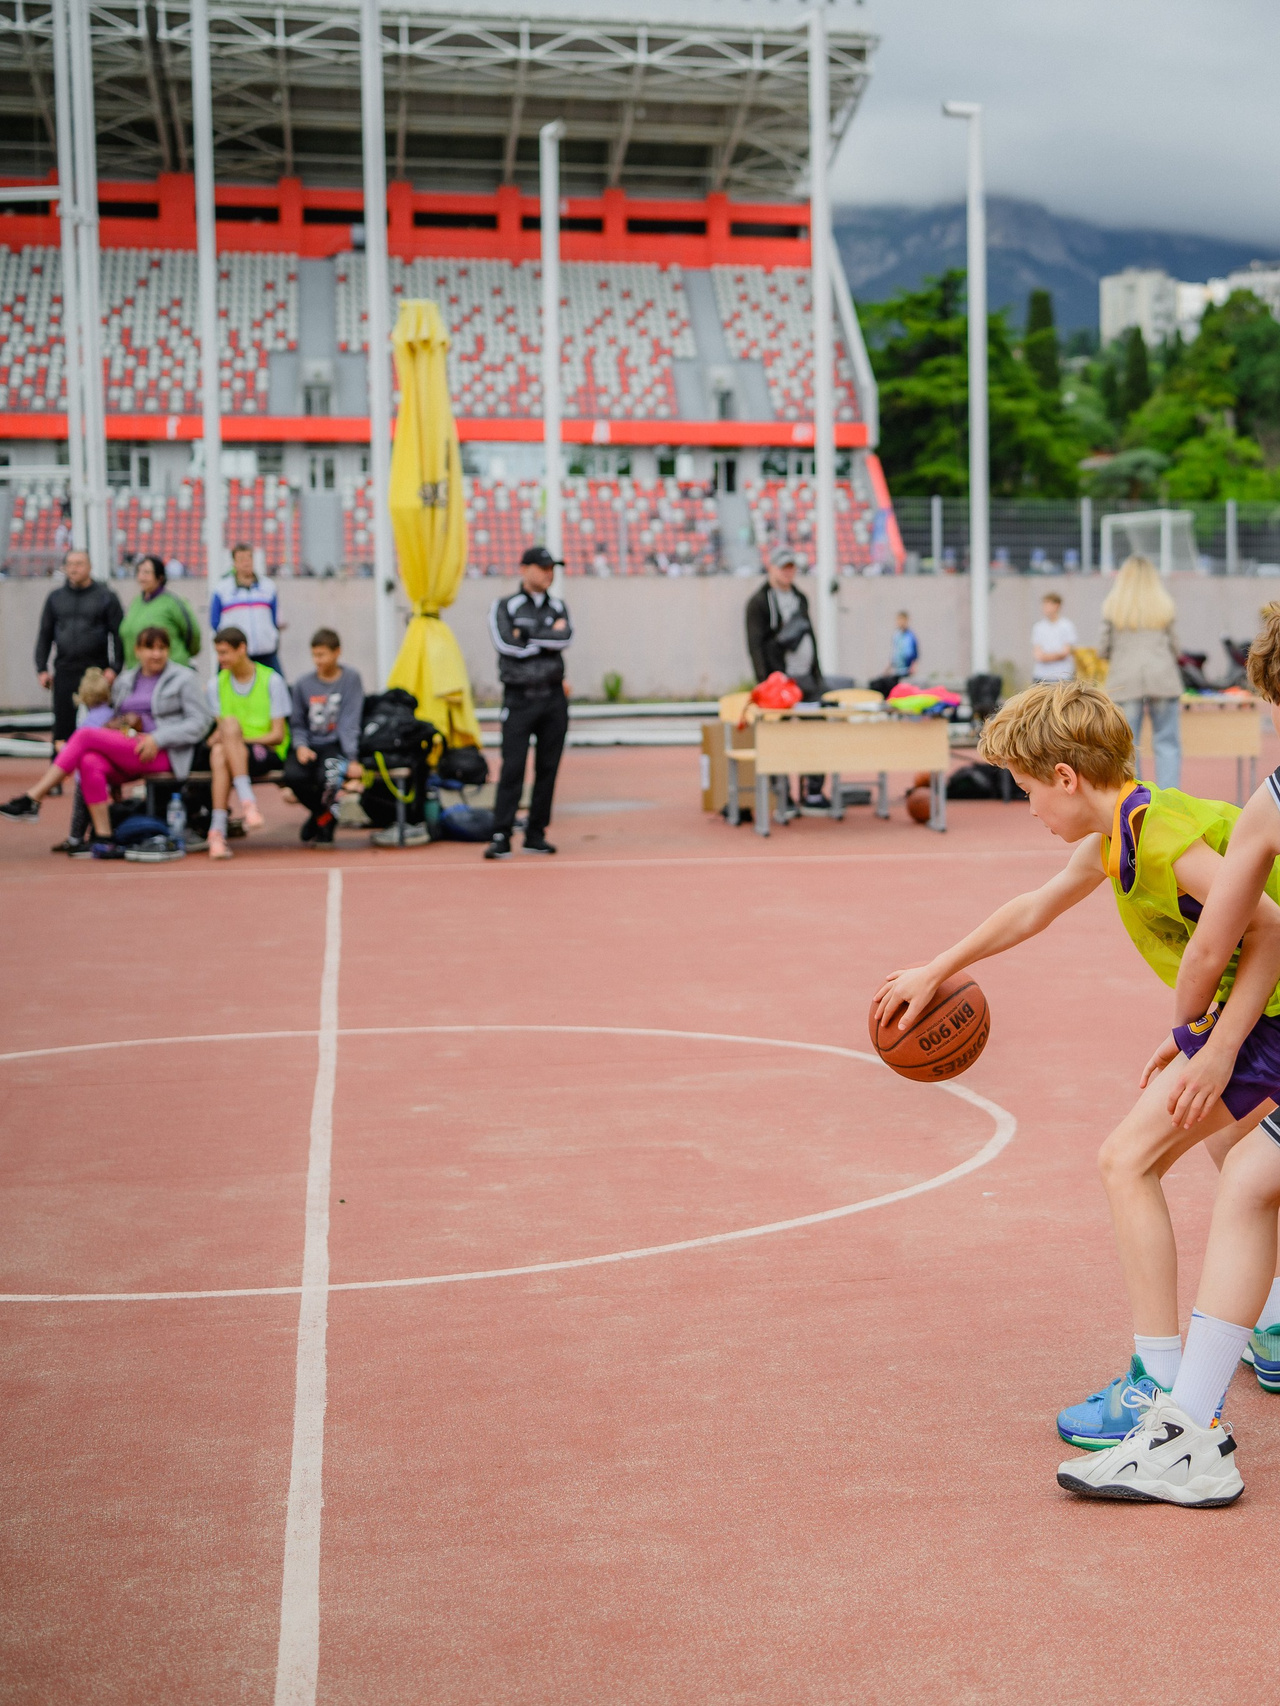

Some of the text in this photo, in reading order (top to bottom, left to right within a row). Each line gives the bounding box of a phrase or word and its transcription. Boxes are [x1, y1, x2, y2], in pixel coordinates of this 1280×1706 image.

[918, 1002, 975, 1052] BM 900
[931, 1021, 989, 1077] TORRES
